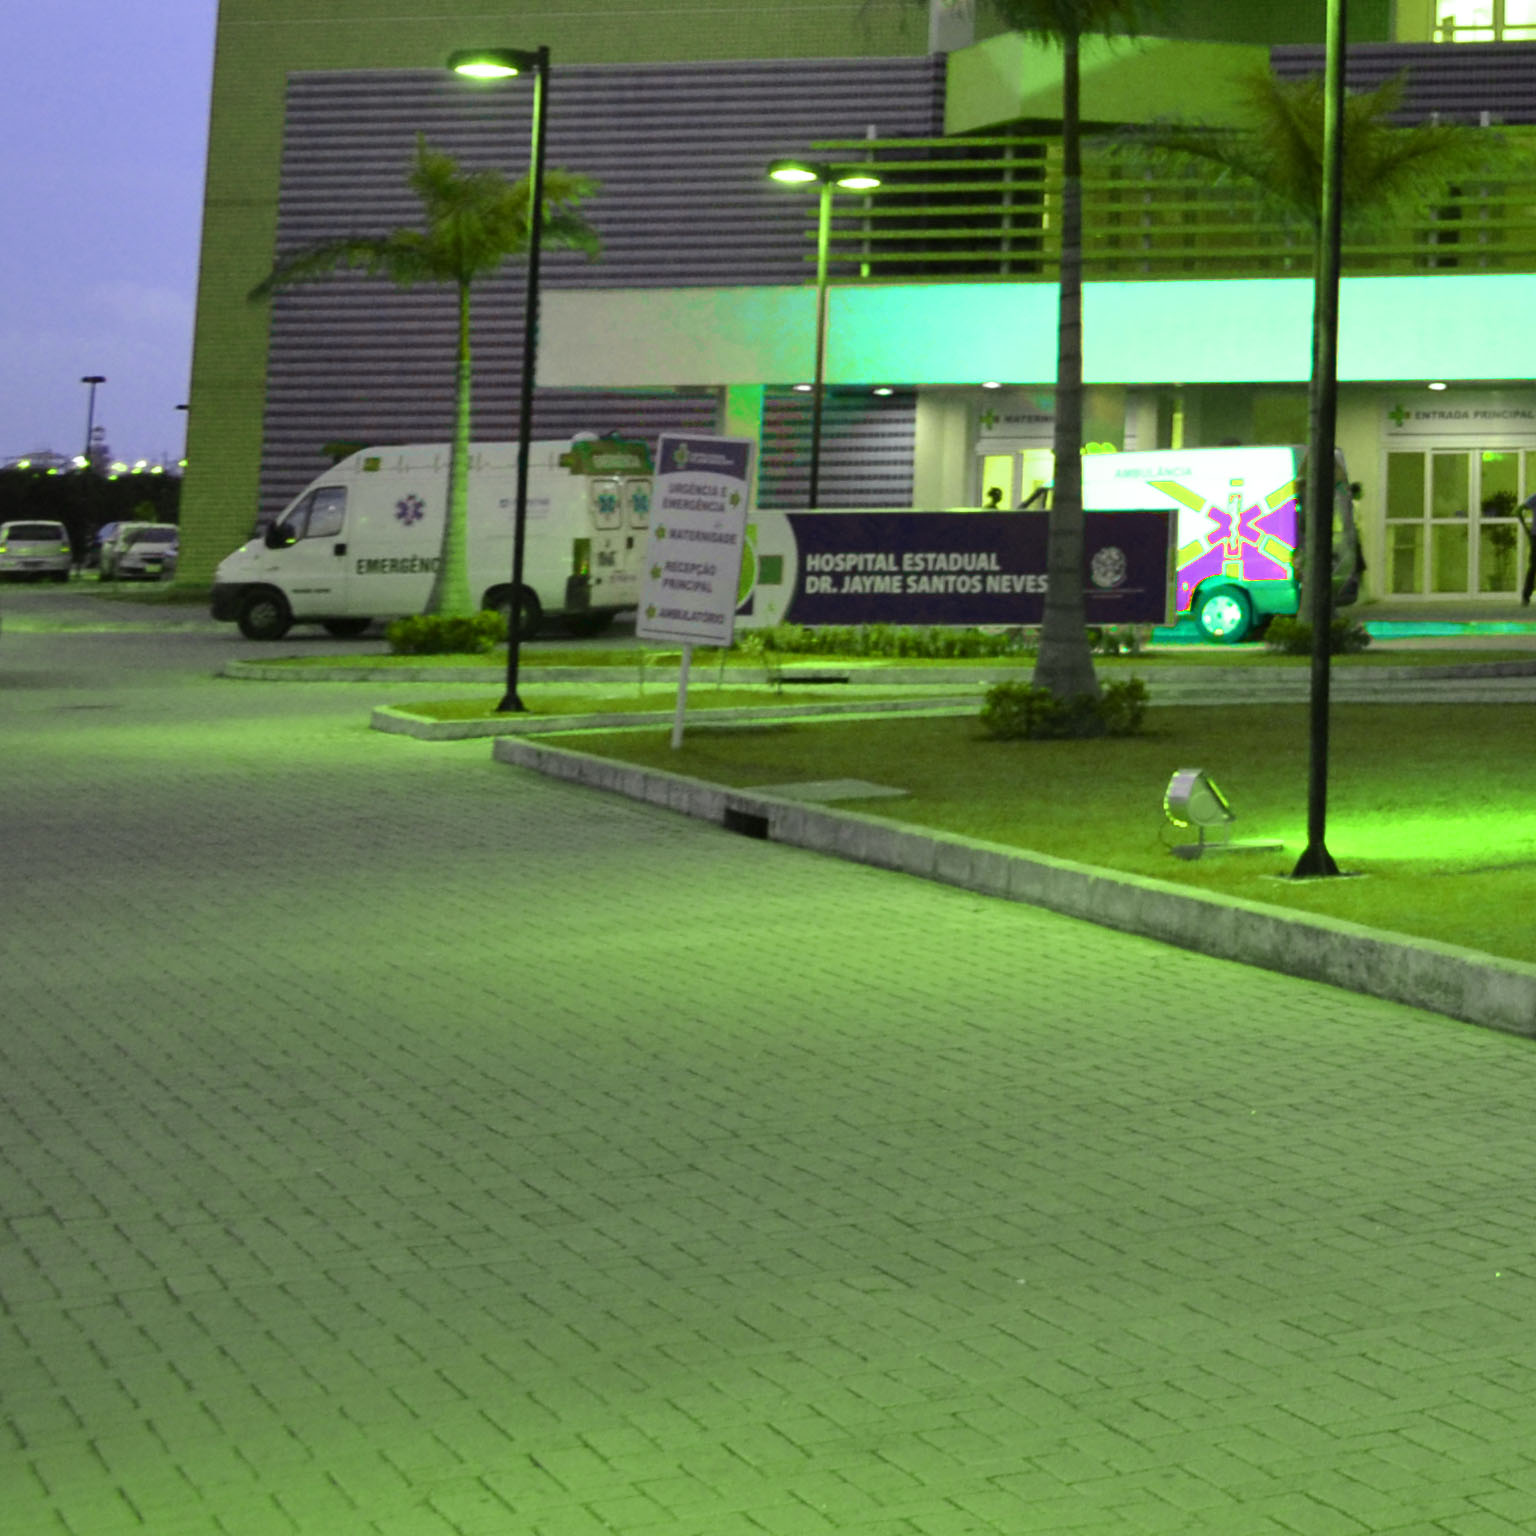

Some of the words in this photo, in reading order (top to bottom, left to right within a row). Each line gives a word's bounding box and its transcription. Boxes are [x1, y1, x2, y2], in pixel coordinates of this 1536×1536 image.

[1414, 410, 1469, 420] ENTRADA
[1472, 410, 1535, 420] PRINCIPAL
[669, 528, 737, 544] MATERNIDADE
[356, 554, 441, 575] EMERGÊNC
[806, 553, 899, 572] HOSPITAL
[902, 553, 1001, 572] ESTADUAL
[805, 575, 837, 594] DR.
[841, 575, 902, 594] JAYME
[906, 575, 982, 594] SANTOS
[986, 575, 1048, 593] NEVES
